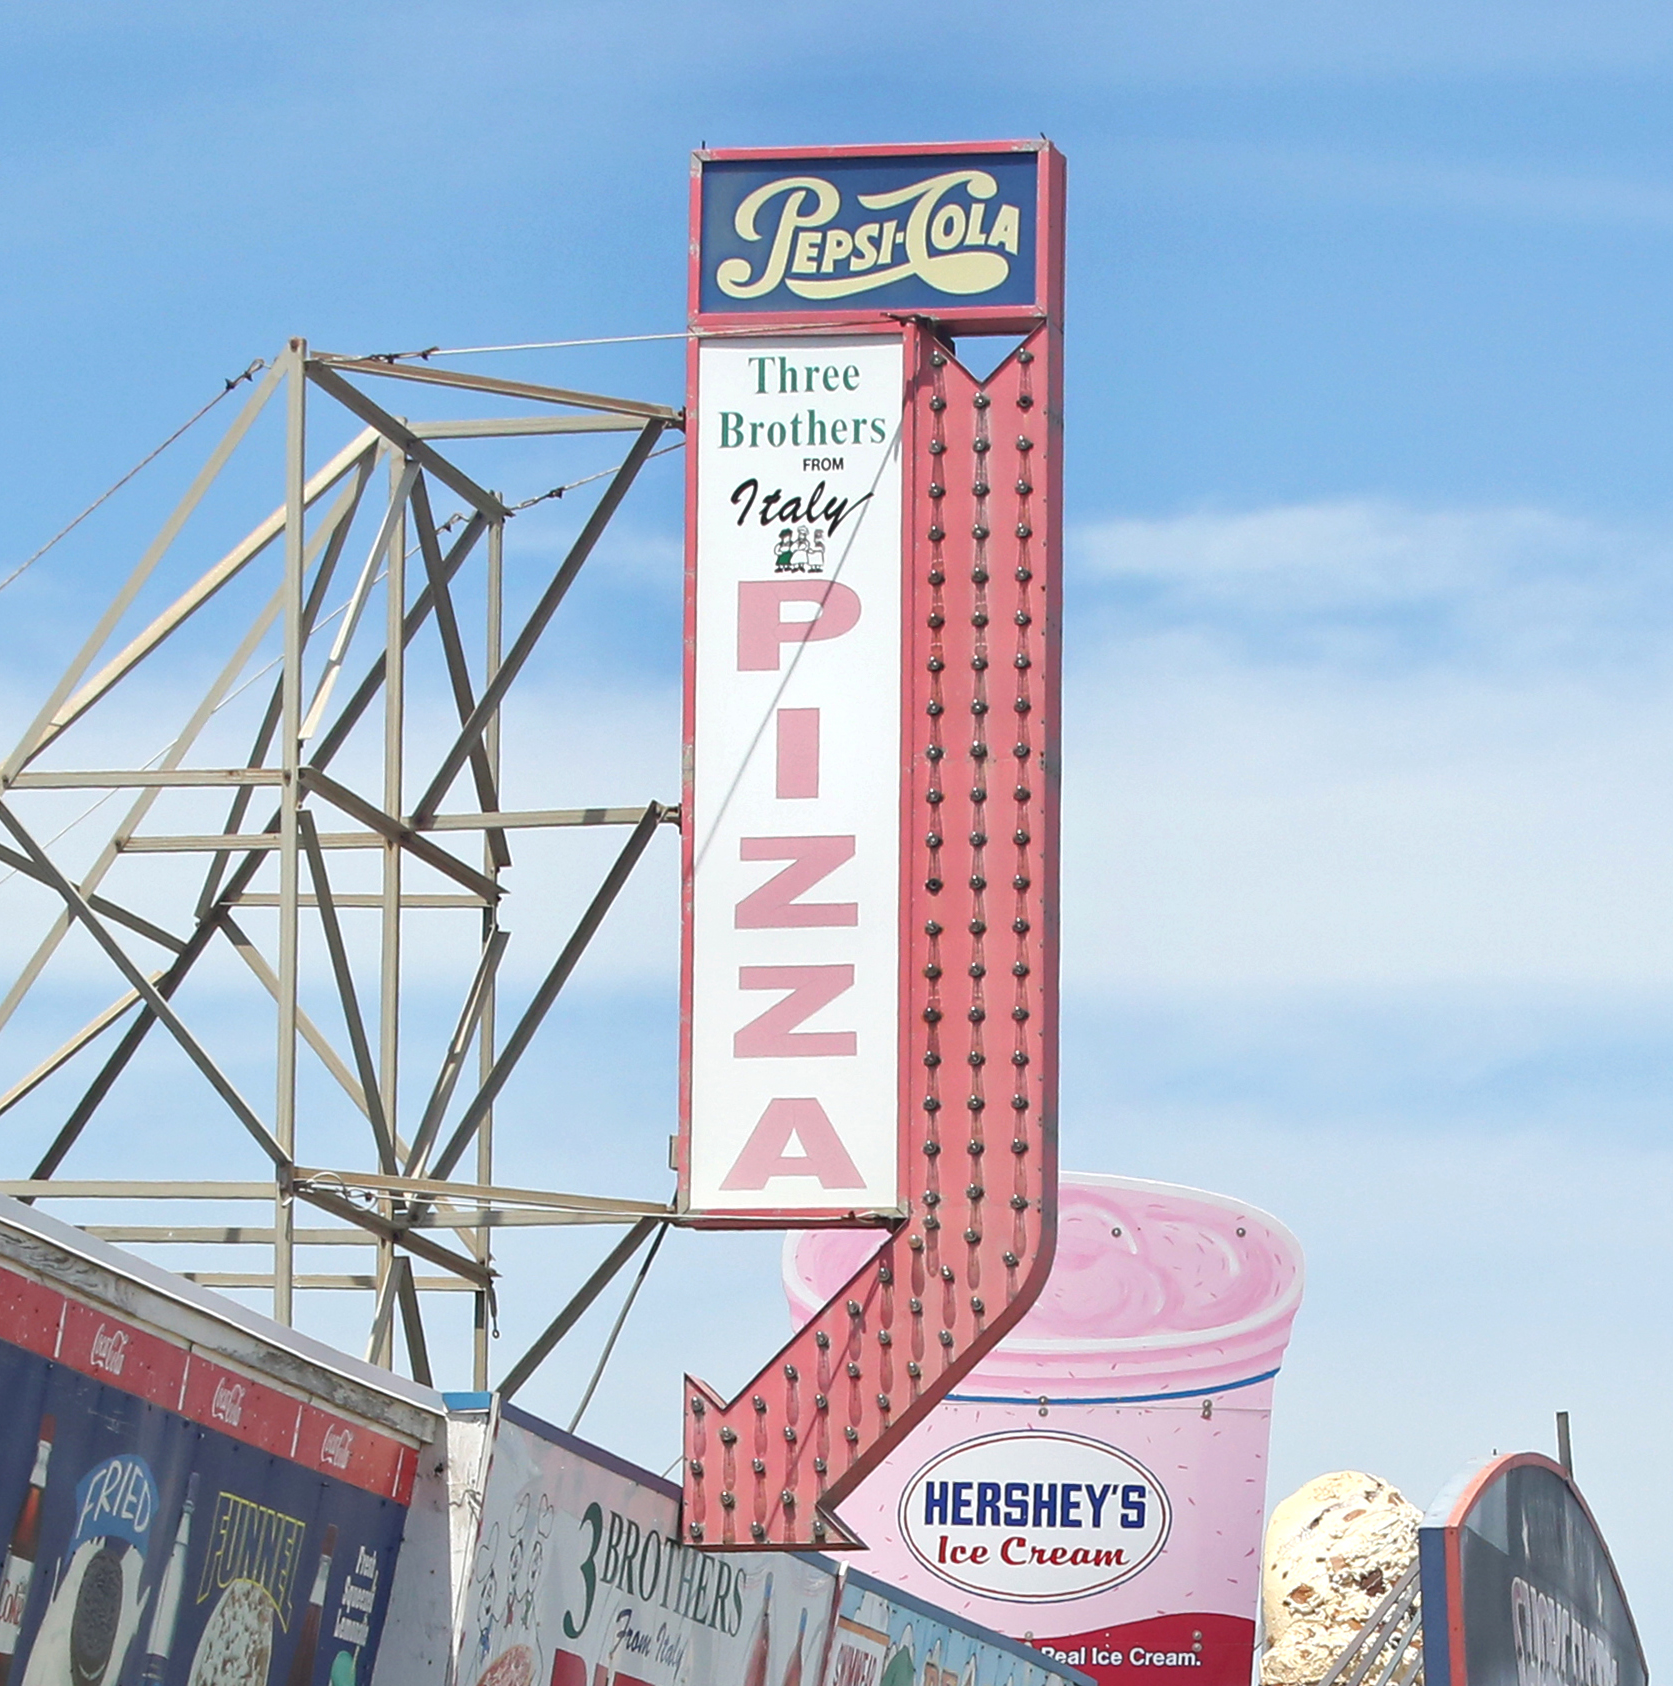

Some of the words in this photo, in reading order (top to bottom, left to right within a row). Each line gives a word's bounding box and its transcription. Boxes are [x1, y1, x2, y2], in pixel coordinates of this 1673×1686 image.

[716, 170, 1021, 299] PEPSI-COLA
[748, 356, 860, 395] Three
[718, 410, 886, 448] Brothers
[803, 458, 844, 471] FROM
[730, 479, 873, 537] Italy
[719, 580, 867, 1191] PIZZA
[75, 1455, 154, 1540] FRIED
[924, 1481, 1146, 1528] HERSHEY'S
[196, 1492, 305, 1632] FUNNEL
[563, 1502, 603, 1639] 3
[600, 1511, 747, 1638] BROTHERS
[938, 1536, 990, 1565] Ice
[1000, 1537, 1130, 1567] Cream
[610, 1610, 651, 1661] From
[656, 1623, 686, 1683] Italy
[1040, 1646, 1087, 1666] Real
[1091, 1647, 1122, 1666] Ice
[1129, 1648, 1201, 1667] Cream.
